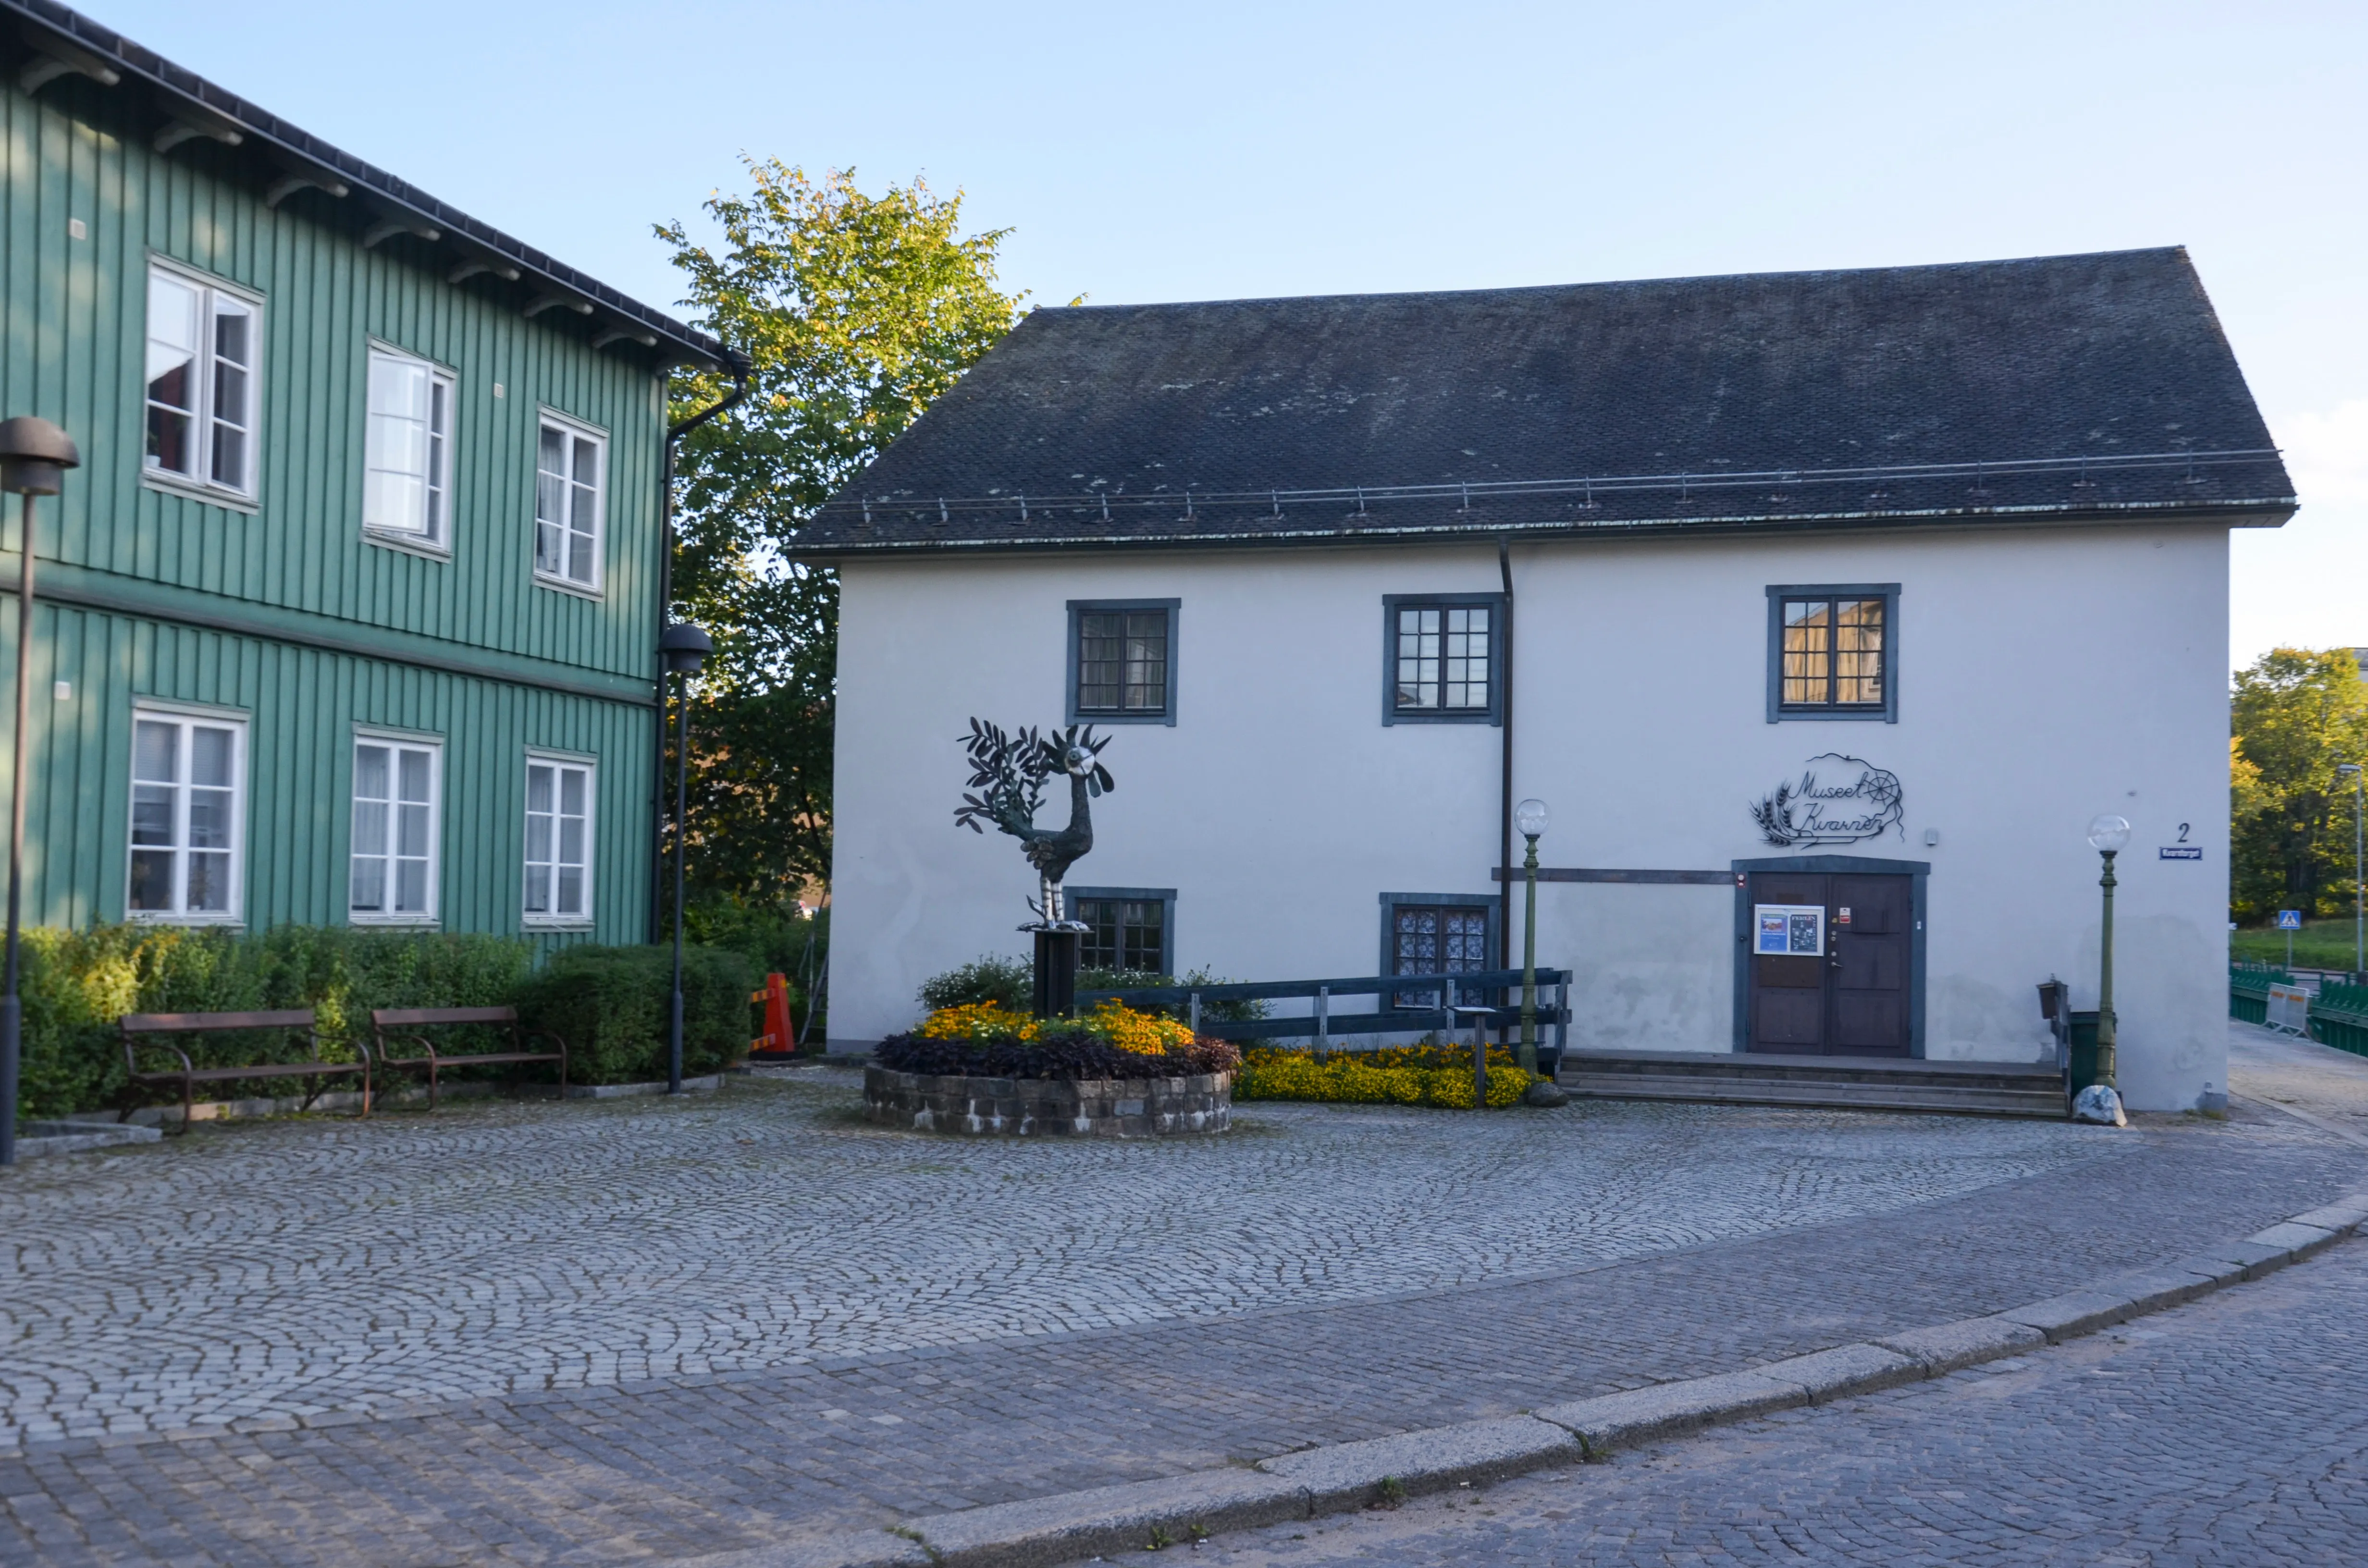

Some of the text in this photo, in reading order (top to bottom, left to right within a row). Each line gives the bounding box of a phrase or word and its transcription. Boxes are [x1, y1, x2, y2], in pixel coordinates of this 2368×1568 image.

[1788, 771, 1868, 799] Museet
[1799, 803, 1883, 831] Kvarnen
[2177, 822, 2190, 843] 2
